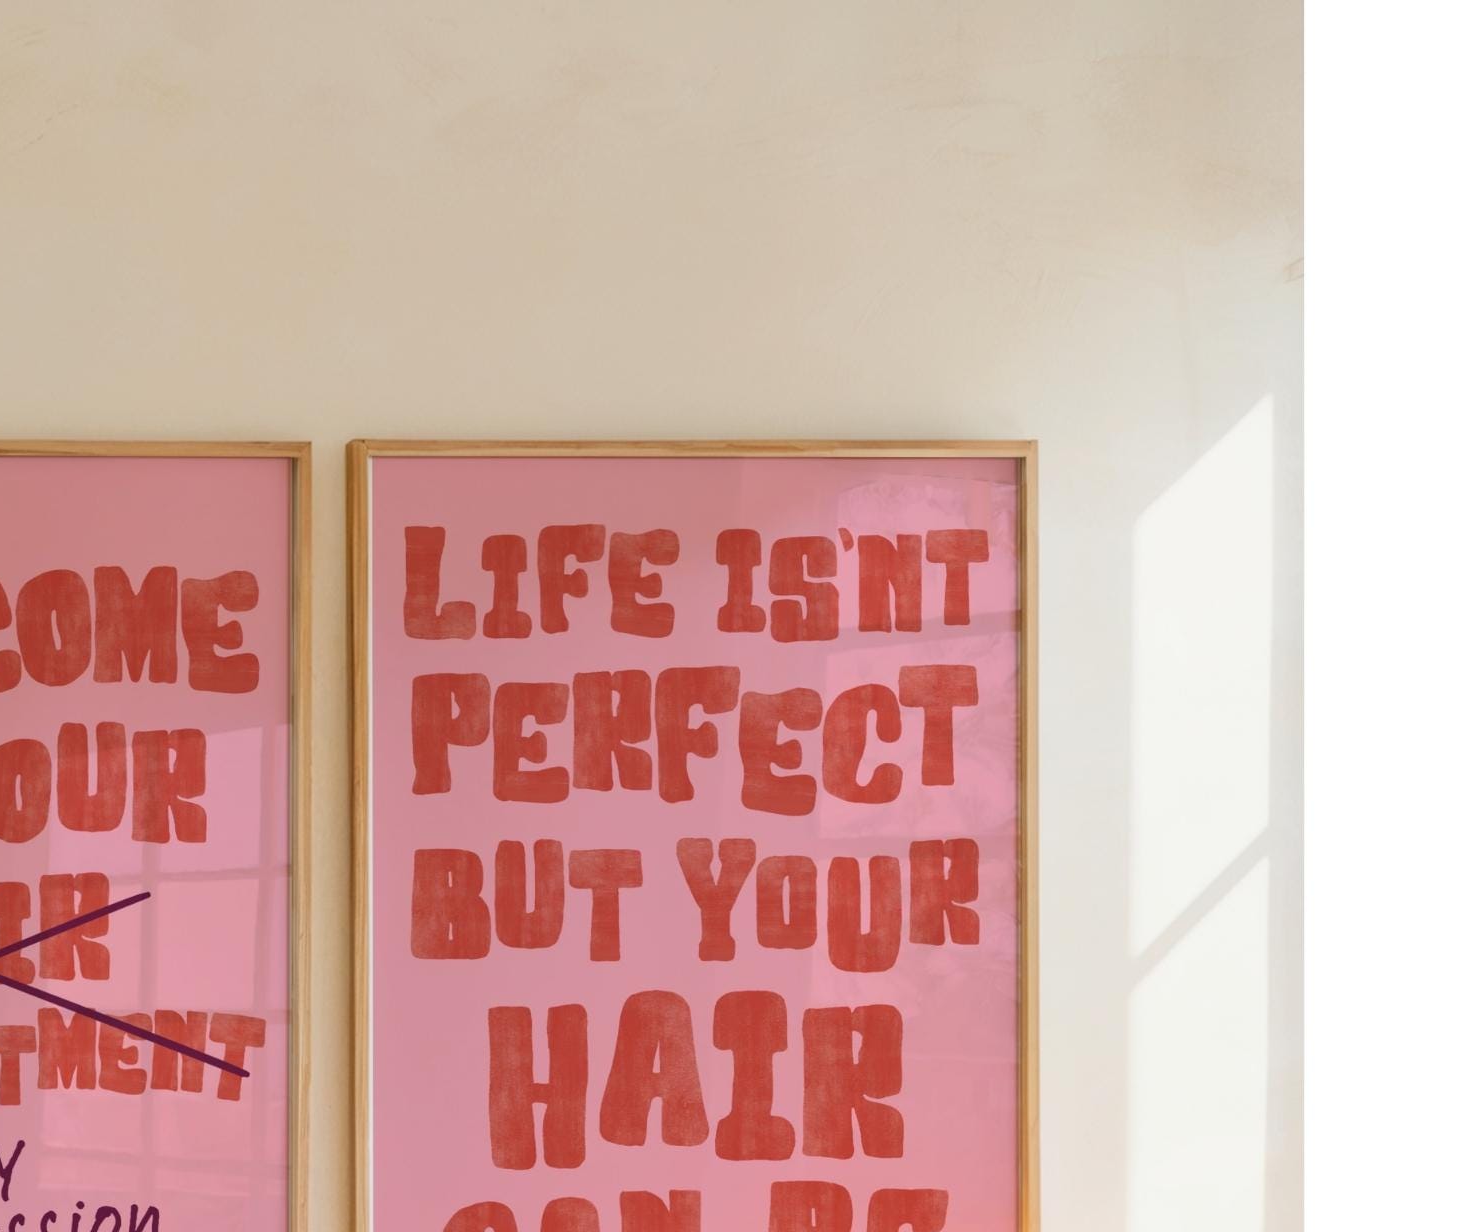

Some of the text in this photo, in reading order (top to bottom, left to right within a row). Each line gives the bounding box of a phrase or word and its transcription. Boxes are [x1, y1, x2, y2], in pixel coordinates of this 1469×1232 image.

[403, 523, 991, 644] LIFE IS'NT
[411, 664, 980, 817] PERFECT
[411, 838, 981, 974] BUT YOUR
[488, 990, 906, 1171] HAIR
